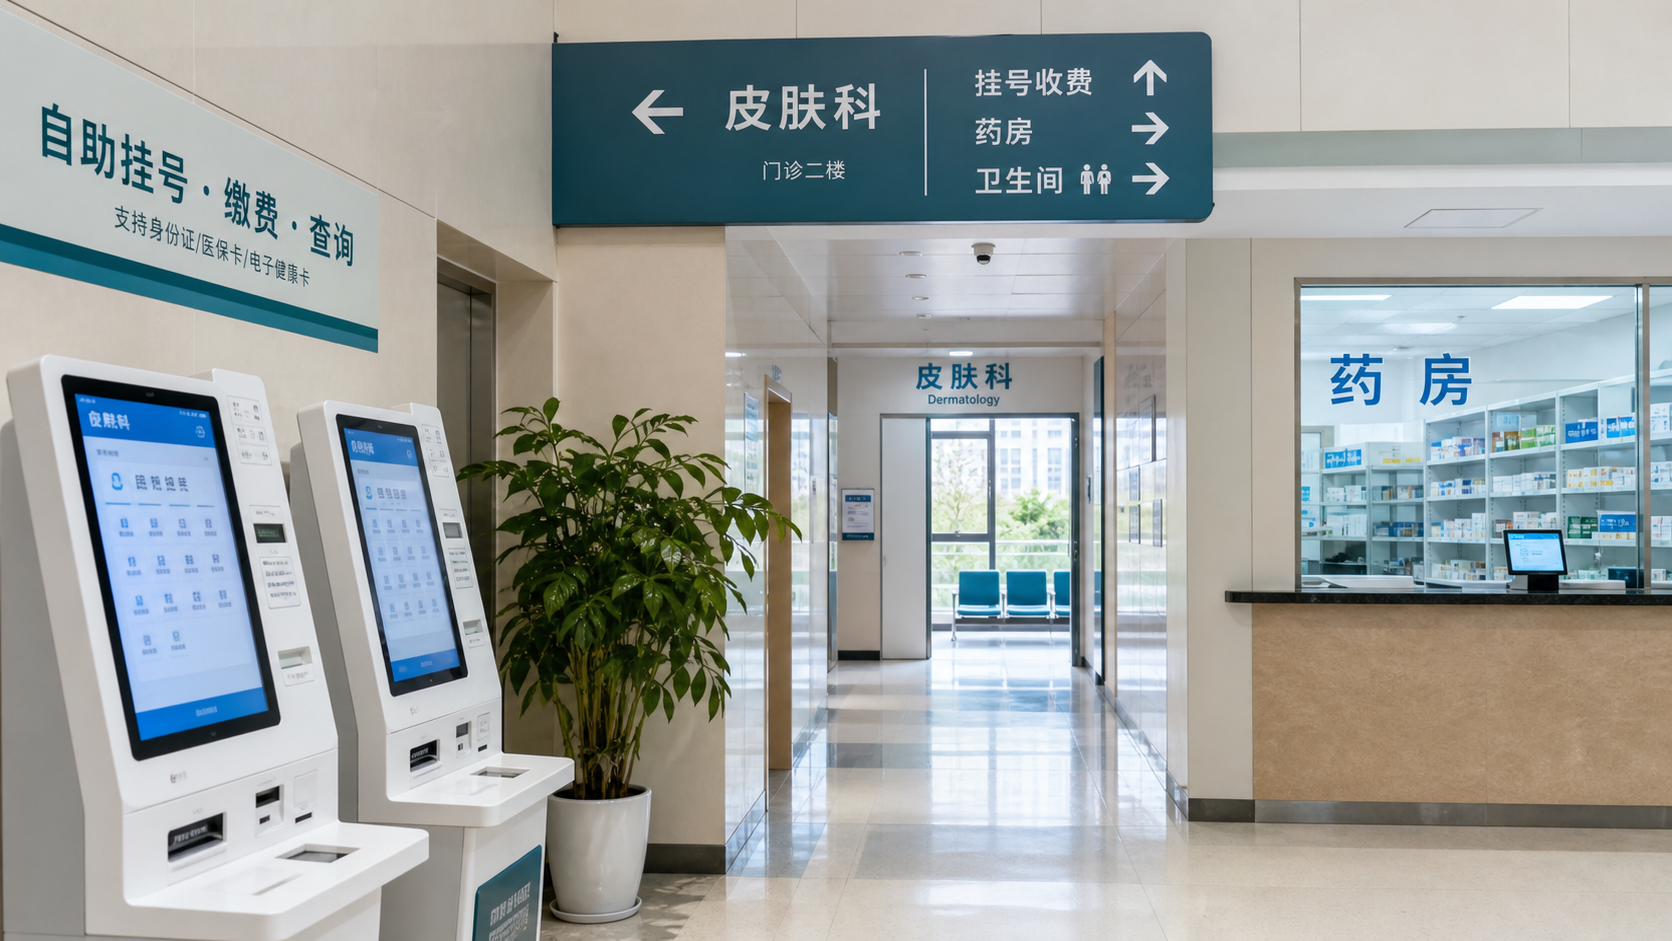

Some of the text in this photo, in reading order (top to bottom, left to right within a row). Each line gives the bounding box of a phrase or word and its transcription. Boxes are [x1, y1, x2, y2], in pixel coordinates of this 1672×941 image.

[975, 68, 1093, 97] 挂号收费
[725, 83, 880, 131] 皮肤科
[976, 117, 1033, 146] 药房
[763, 160, 846, 181] 门诊二楼
[976, 166, 1063, 195] 卫生间
[114, 206, 310, 287] 支持身份证/医保卡/电子健康卡
[916, 362, 1012, 390] 皮肤科
[1330, 353, 1472, 406] 药房
[928, 394, 1000, 407] Dermatology
